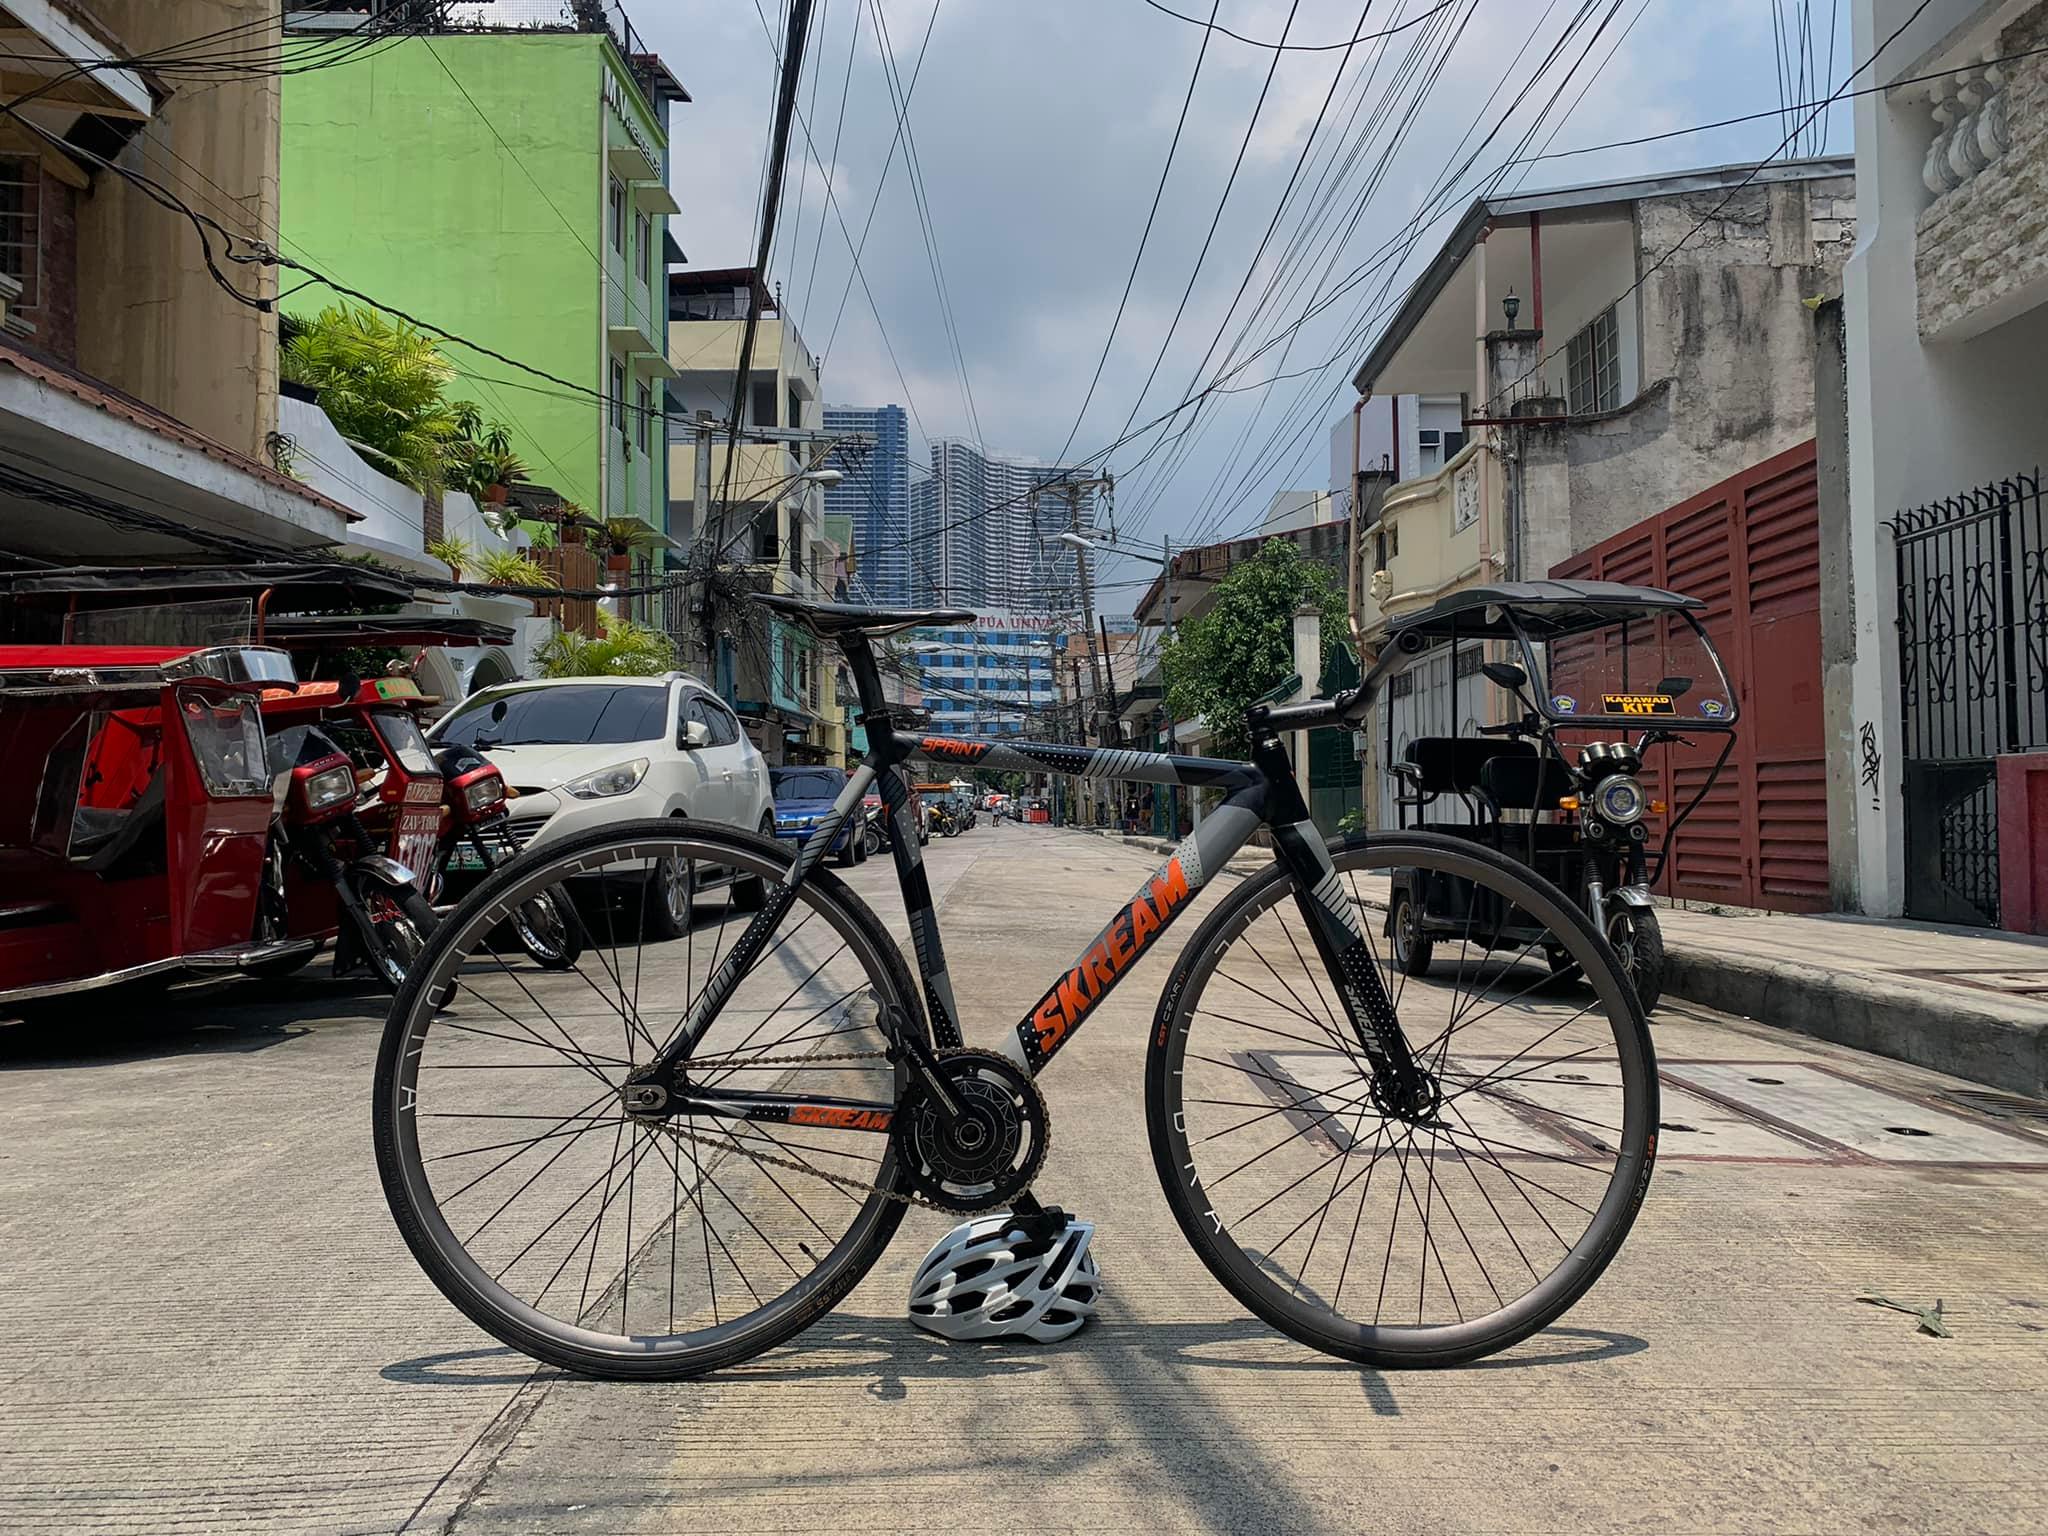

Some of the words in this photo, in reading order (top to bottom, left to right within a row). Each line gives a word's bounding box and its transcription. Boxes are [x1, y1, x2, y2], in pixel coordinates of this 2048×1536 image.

[1605, 696, 1669, 704] KAGAWAD
[1623, 703, 1655, 713] KIT
[920, 737, 988, 757] SPRINT
[1033, 857, 1190, 1053] SKREAM
[1162, 983, 1182, 1022] CZAR
[1344, 984, 1383, 1054] SKREAM
[791, 1106, 894, 1131] SKREAM
[1635, 1159, 1652, 1200] CZAR
